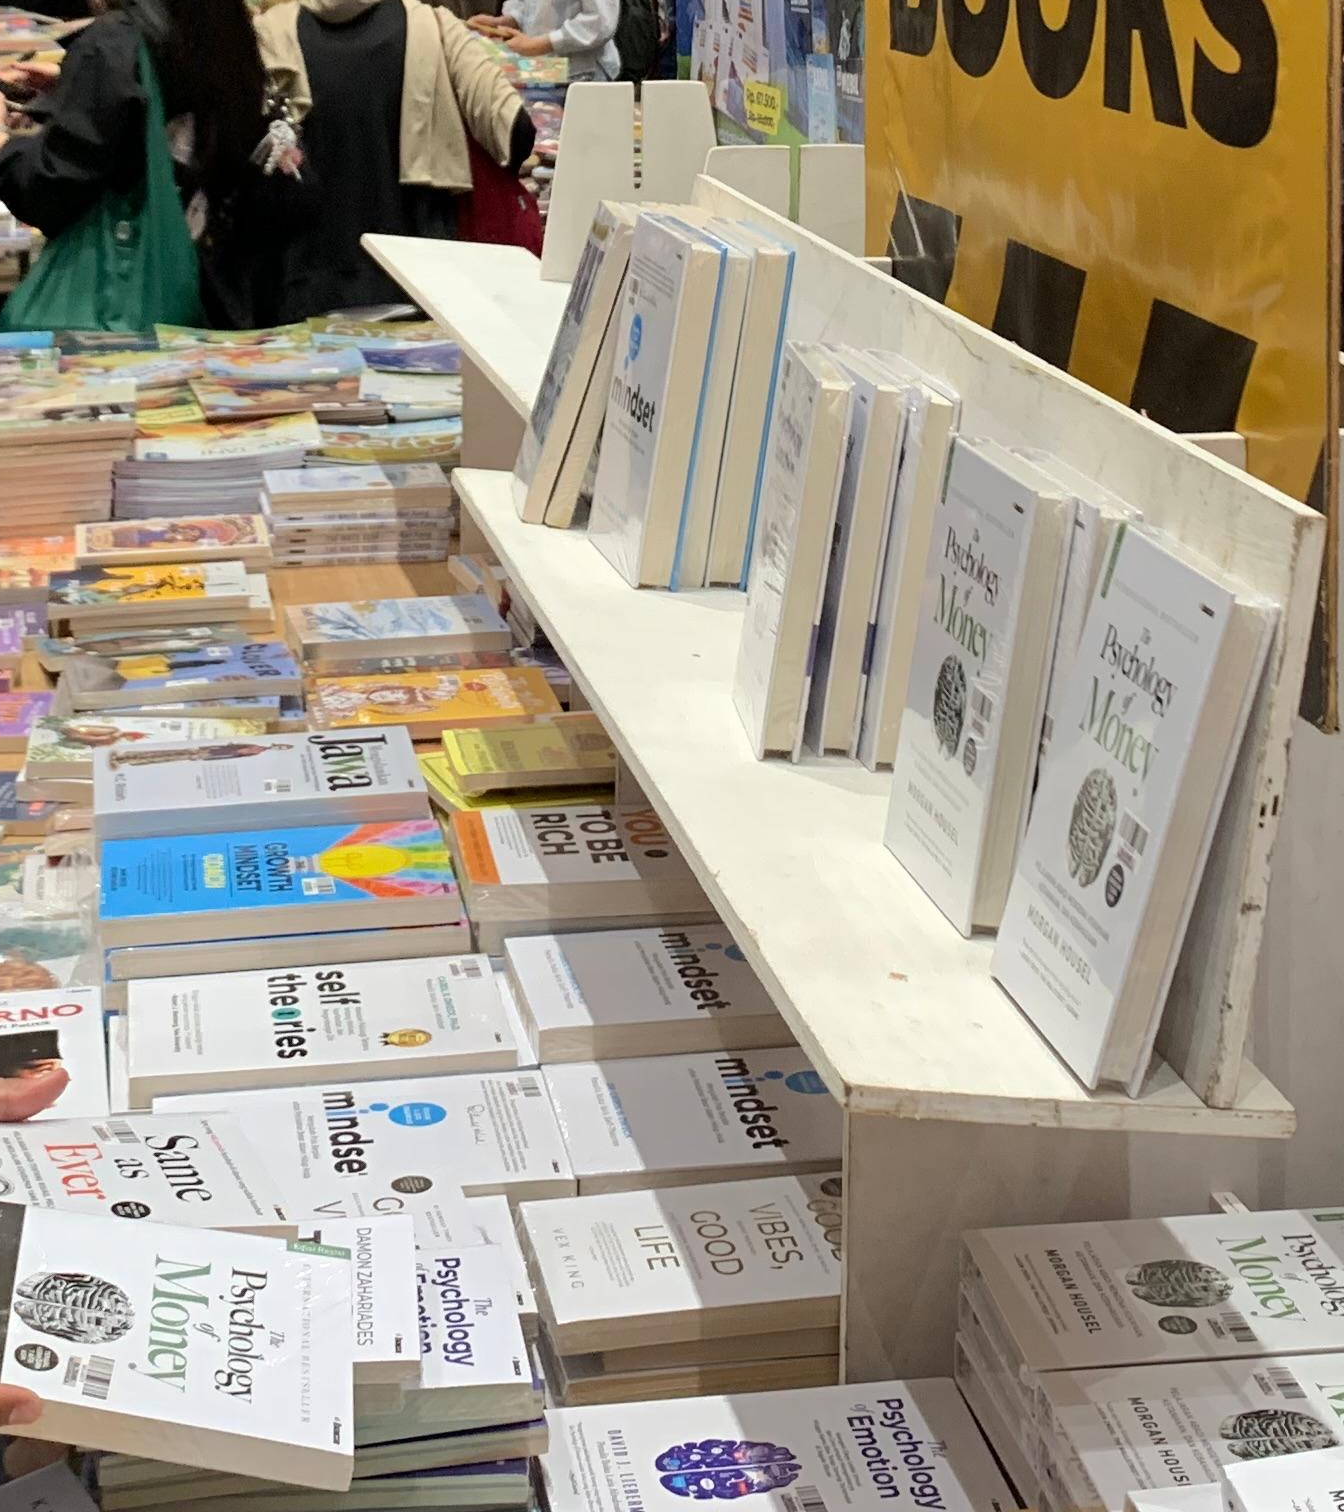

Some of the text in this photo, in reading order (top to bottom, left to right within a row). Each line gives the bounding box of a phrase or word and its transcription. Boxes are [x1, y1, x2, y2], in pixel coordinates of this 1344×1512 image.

[611, 374, 656, 433] mindset
[945, 525, 1002, 607] Psychology
[933, 573, 994, 678] Money
[1099, 622, 1177, 718] Psychology
[307, 733, 389, 792] Jawa
[1079, 675, 1159, 796] Money
[530, 812, 580, 858] RICH
[576, 809, 630, 865] TO BE
[621, 808, 671, 848] YOU
[233, 844, 263, 892] MINDSET
[264, 841, 294, 893] GROWTH
[657, 931, 731, 1010] mindset
[1026, 903, 1060, 952] MORGAN
[1058, 938, 1093, 985] HOUSEL
[267, 973, 317, 1060] theories
[315, 970, 361, 1005] self
[322, 1090, 374, 1176] mindse
[714, 1057, 790, 1150] mindset
[44, 1140, 107, 1202] Ever
[114, 1155, 151, 1180] as
[144, 1131, 213, 1204] Same
[552, 1228, 585, 1290] VEX KING
[634, 1224, 681, 1271] LIFE
[690, 1210, 744, 1276] GOOD
[749, 1202, 804, 1270] VIBES,
[356, 1227, 374, 1347] DAMON ZAHARIADES
[472, 1297, 493, 1317] The
[1044, 1248, 1102, 1335] MORGAN HOUSEL
[1216, 1235, 1308, 1323] Money
[1278, 1271, 1309, 1284] of
[128, 1253, 212, 1393] Money
[193, 1321, 221, 1343] of
[213, 1266, 268, 1405] Psychology
[269, 1330, 286, 1349] The
[431, 1257, 476, 1367] Psychology
[301, 1355, 311, 1424] BESTSELLER
[1127, 1395, 1162, 1446] MORGAN
[607, 1428, 629, 1457] DAVID
[846, 1415, 901, 1499] Emotion
[877, 1397, 947, 1510] Psychology
